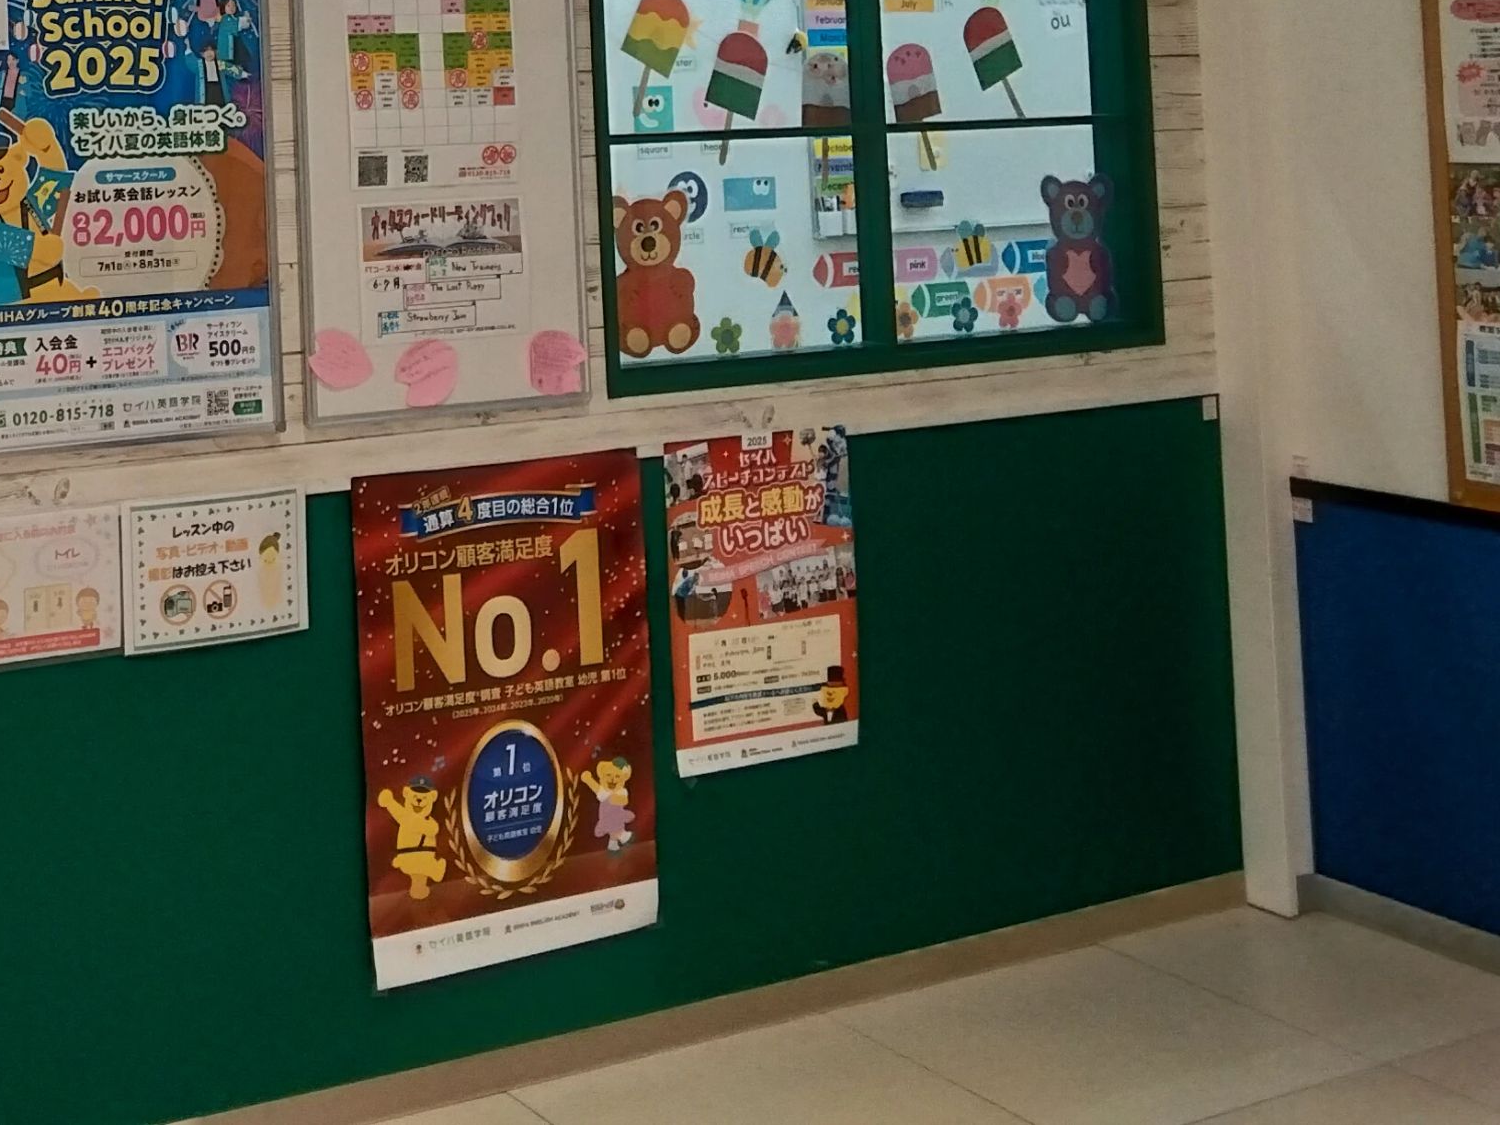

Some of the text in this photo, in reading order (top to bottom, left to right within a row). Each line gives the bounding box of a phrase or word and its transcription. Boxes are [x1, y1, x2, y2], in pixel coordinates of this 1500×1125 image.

[41, 9, 162, 41] School
[815, 15, 846, 25] Februar
[46, 46, 160, 91] 2025
[74, 132, 221, 153] セイハ夏の英語体験
[640, 145, 668, 154] square
[106, 172, 167, 182] サマースクール
[75, 186, 200, 203] お試し英会話レッスン
[909, 259, 926, 271] pink
[35, 334, 78, 352] 入会金
[36, 353, 81, 375] 40円
[102, 358, 155, 372] プレゼント
[13, 403, 114, 427] 0120-815-718
[747, 436, 767, 447] 2025
[739, 450, 777, 466] セイハ
[702, 460, 815, 489] スピーチコンテスト
[700, 488, 824, 524] 成長と感動が
[173, 521, 235, 538] レッスン中の
[721, 520, 808, 553] いっぱい
[55, 547, 80, 559] トイレ
[385, 535, 554, 576] オリコン顧客満足度
[392, 528, 604, 692] No.1
[483, 784, 543, 810] オリコン
[484, 804, 542, 823] 顧客満足度
